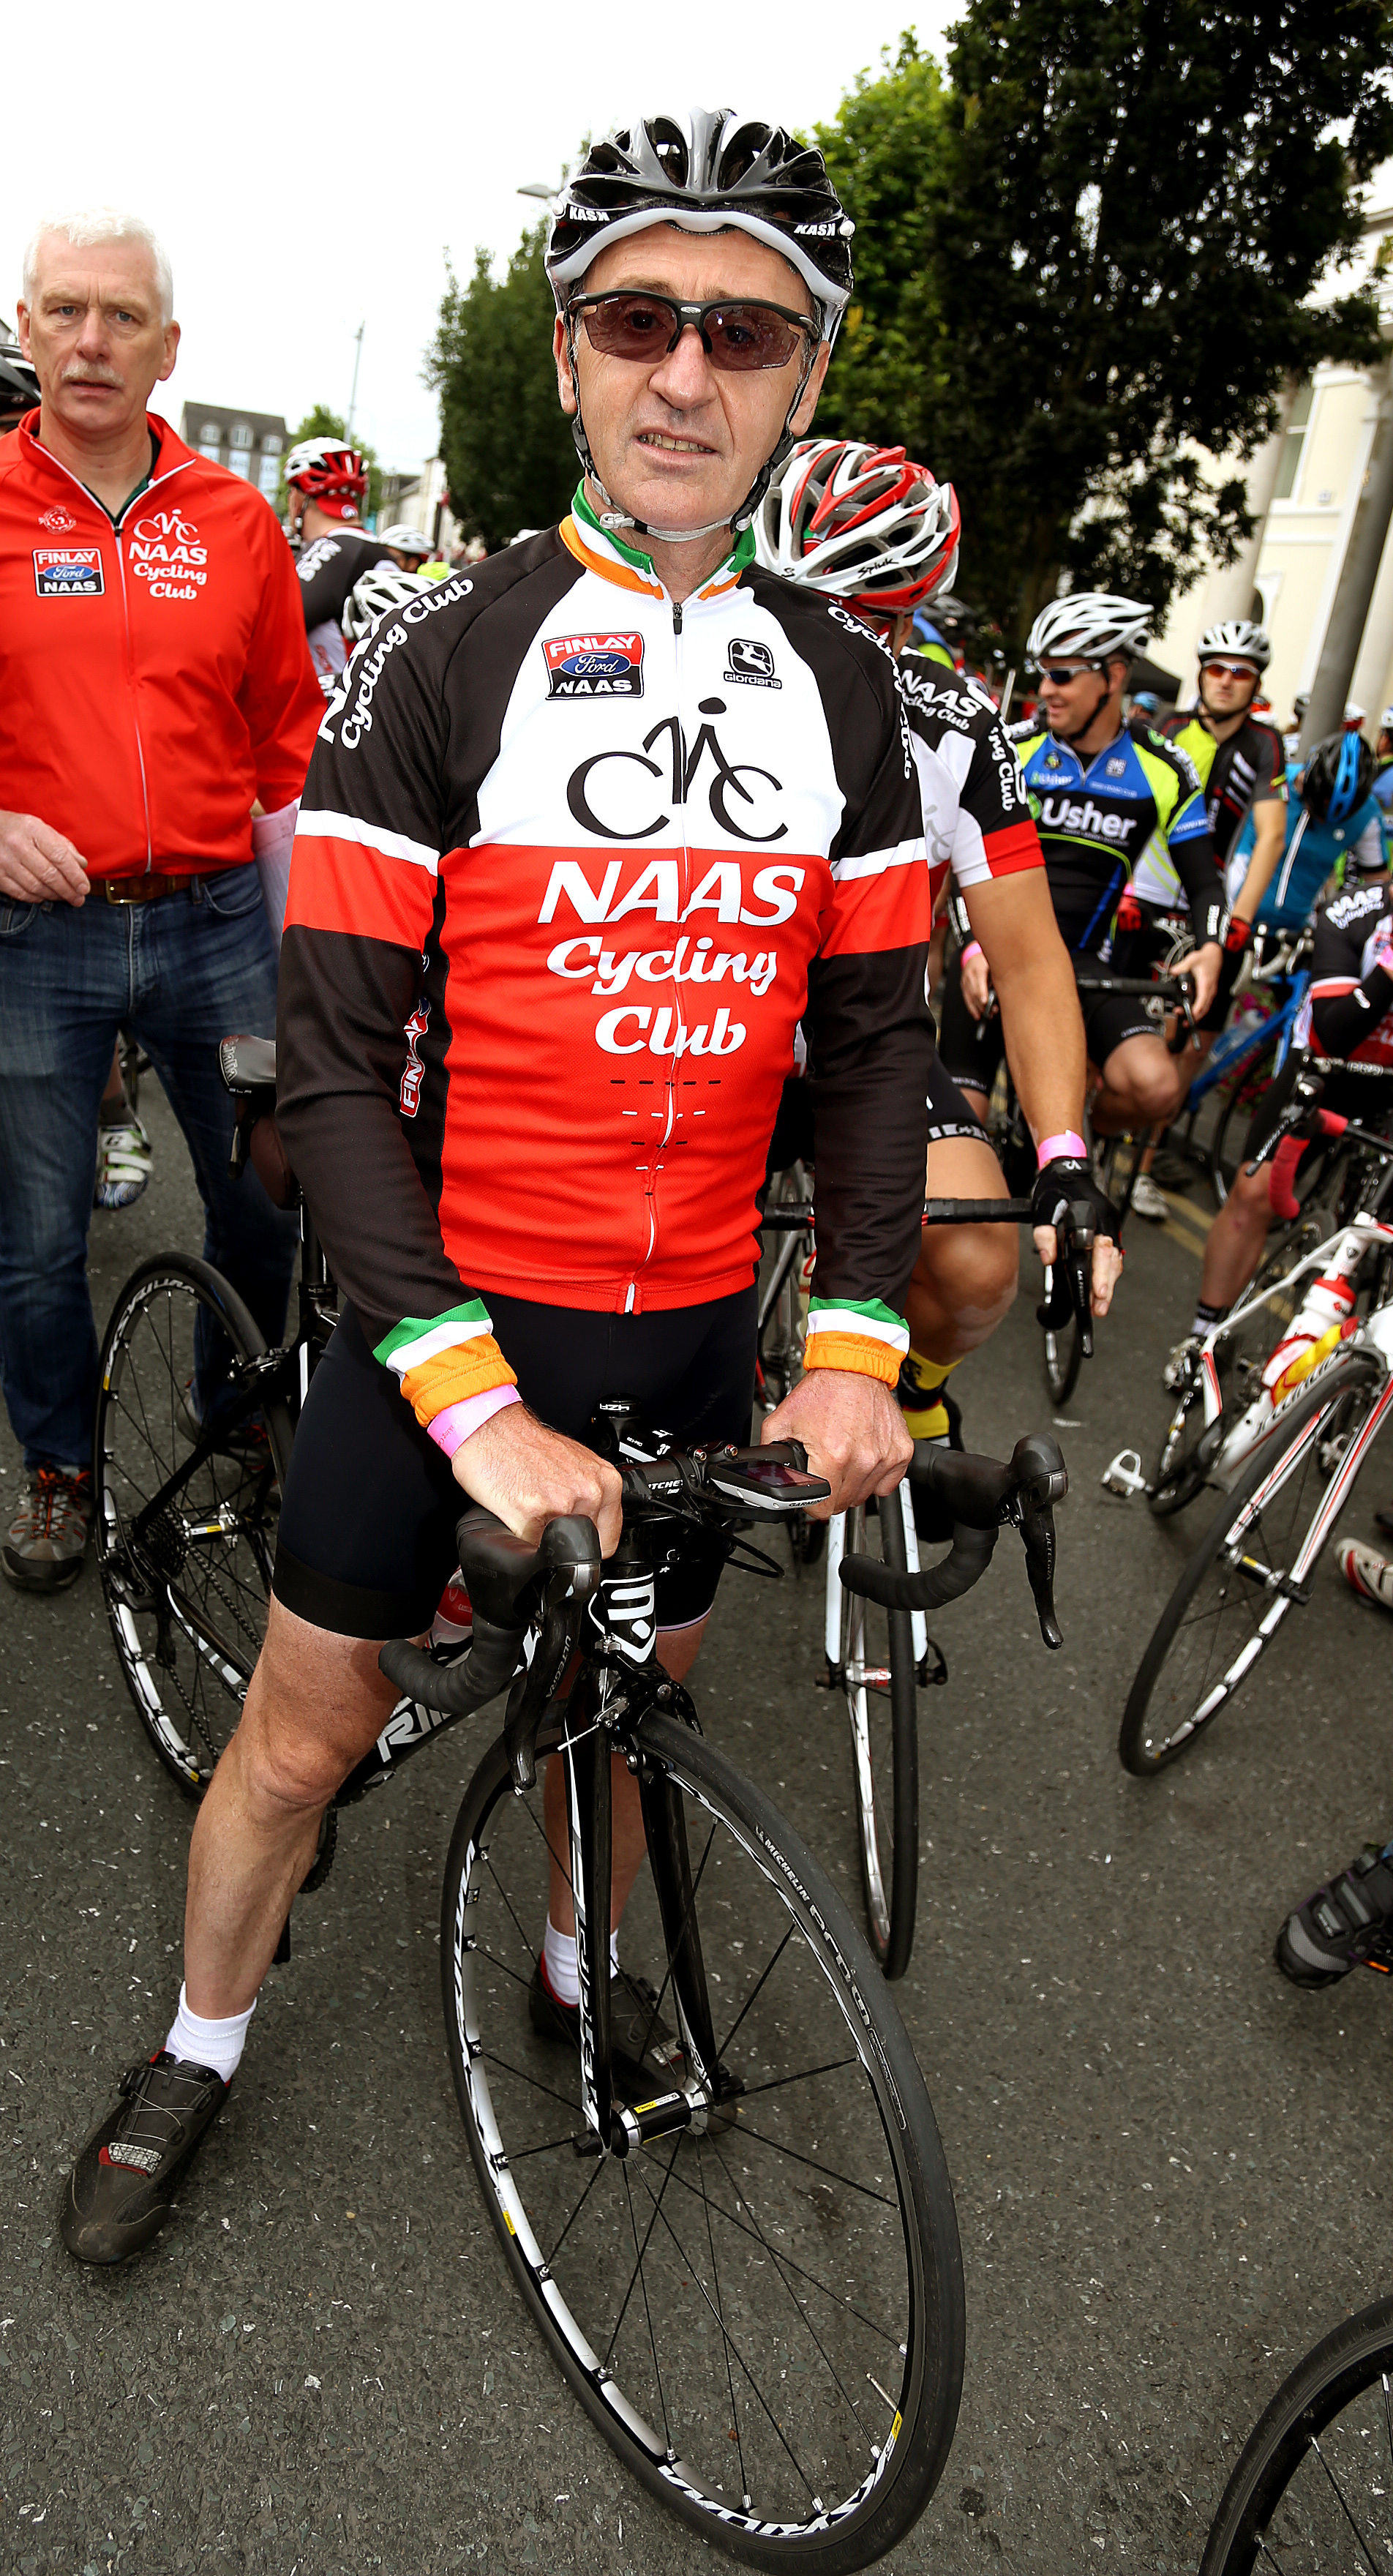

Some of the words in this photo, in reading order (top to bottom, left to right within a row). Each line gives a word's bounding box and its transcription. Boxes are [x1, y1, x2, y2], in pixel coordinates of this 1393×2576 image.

[569, 206, 610, 222] KASK
[794, 222, 836, 236] KASK
[38, 550, 97, 565] FINLAY
[129, 542, 208, 566] NAAS
[52, 565, 85, 580] Ford
[133, 563, 207, 585] Cycling
[43, 580, 97, 593] NAAS
[149, 582, 198, 600] Club
[549, 634, 637, 657] FINLAY
[340, 623, 408, 749] Cycling
[402, 578, 474, 624] Club
[574, 654, 618, 674] Ford
[556, 678, 633, 694] NAAS
[901, 669, 983, 717] NAAS
[936, 708, 970, 730] Club
[999, 761, 1016, 812] Club
[1041, 796, 1137, 840] Usher
[537, 860, 806, 927] NAAS
[547, 935, 778, 997] Cycling
[595, 1006, 747, 1058] Club
[789, 1499, 823, 1507] GARMIN
[546, 1634, 571, 1698] ULTEGRA
[764, 1838, 811, 1902] MICHELIN
